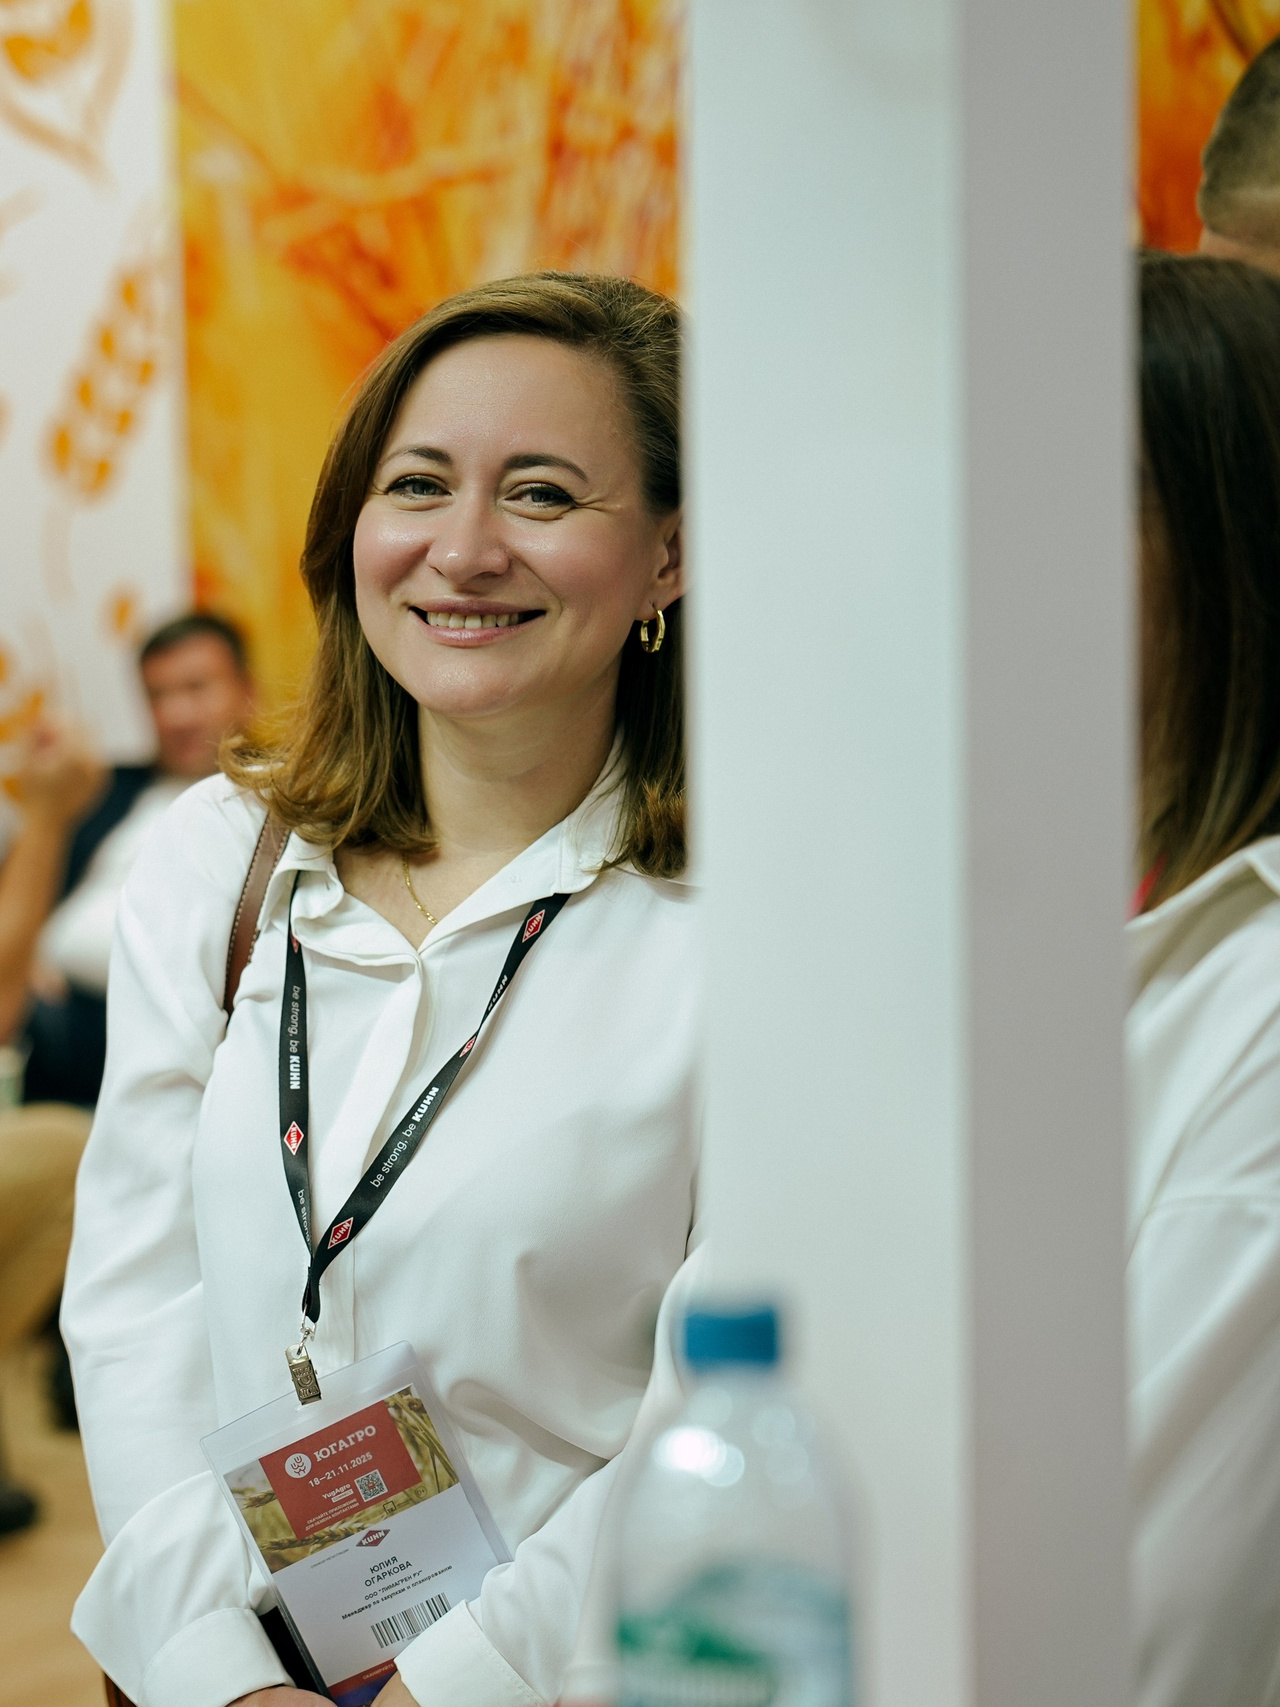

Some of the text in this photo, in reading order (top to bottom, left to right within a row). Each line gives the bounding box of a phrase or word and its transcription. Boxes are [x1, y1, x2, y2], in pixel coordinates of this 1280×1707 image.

[525, 914, 542, 937] KUHN
[292, 985, 301, 1000] be
[289, 1040, 299, 1053] be
[289, 1055, 301, 1090] KUHN
[289, 1125, 298, 1150] KUHN
[370, 1086, 440, 1188] be strong, be KUHN
[297, 1188, 305, 1205] be
[331, 1222, 350, 1244] KUHN
[313, 1425, 377, 1462] ЮГАГРО
[322, 1483, 351, 1500] YugAgro
[361, 1530, 386, 1546] KUHN
[364, 1560, 412, 1587] ОГАРКОВА
[369, 1556, 398, 1574] ЮЛИЯ
[341, 1603, 372, 1620] Менеджер
[380, 1587, 406, 1603] закупкам
[411, 1565, 452, 1588] планированию
[364, 1591, 378, 1601] ООО
